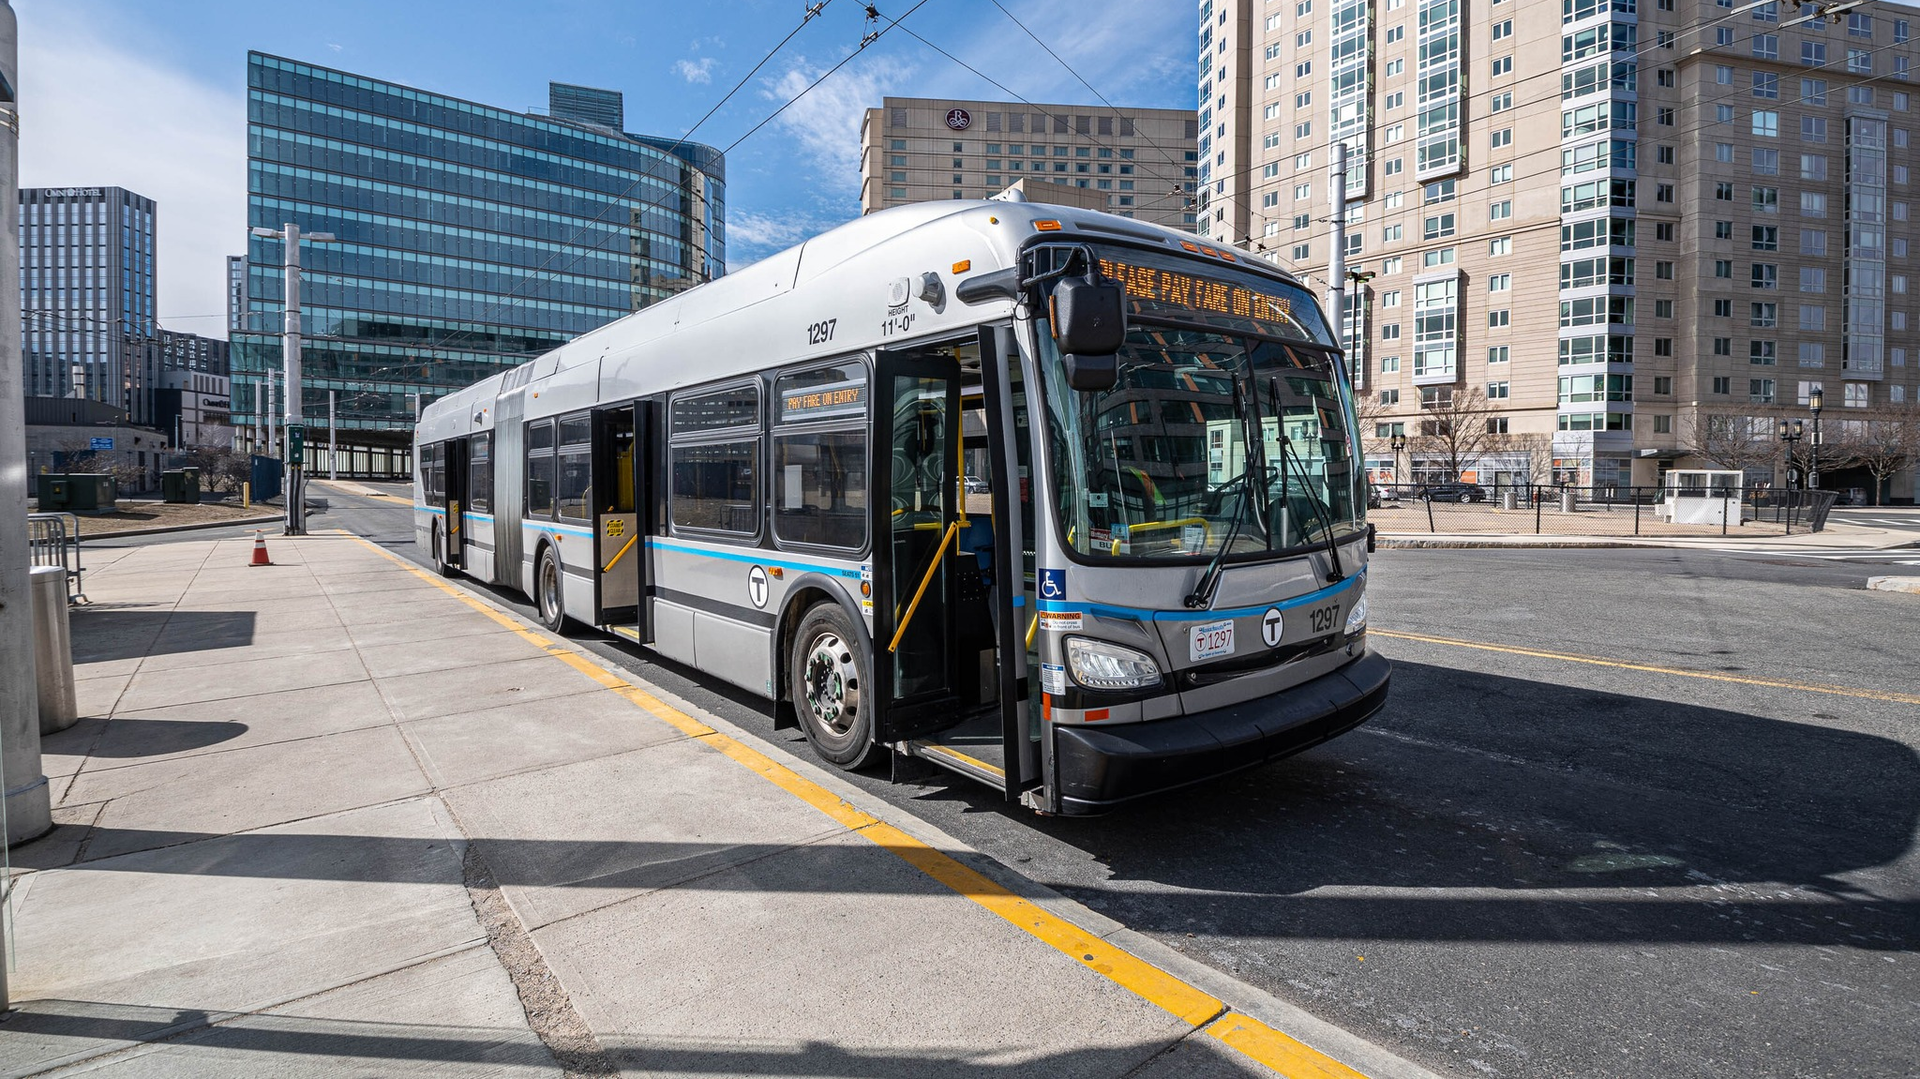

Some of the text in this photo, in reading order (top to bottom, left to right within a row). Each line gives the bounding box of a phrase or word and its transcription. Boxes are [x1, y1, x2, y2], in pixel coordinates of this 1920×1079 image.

[1161, 272, 1191, 305] PAY
[1195, 280, 1229, 312] FARE
[1233, 288, 1250, 317] ON
[1254, 292, 1291, 324] ENTRY
[888, 305, 909, 317] HEIGHT
[807, 318, 837, 345] 1297
[881, 313, 916, 336] 11'-0"
[787, 386, 859, 410] PAY FARE ON ENTRY
[1309, 604, 1340, 634] 1297
[1208, 629, 1232, 650] 1297
